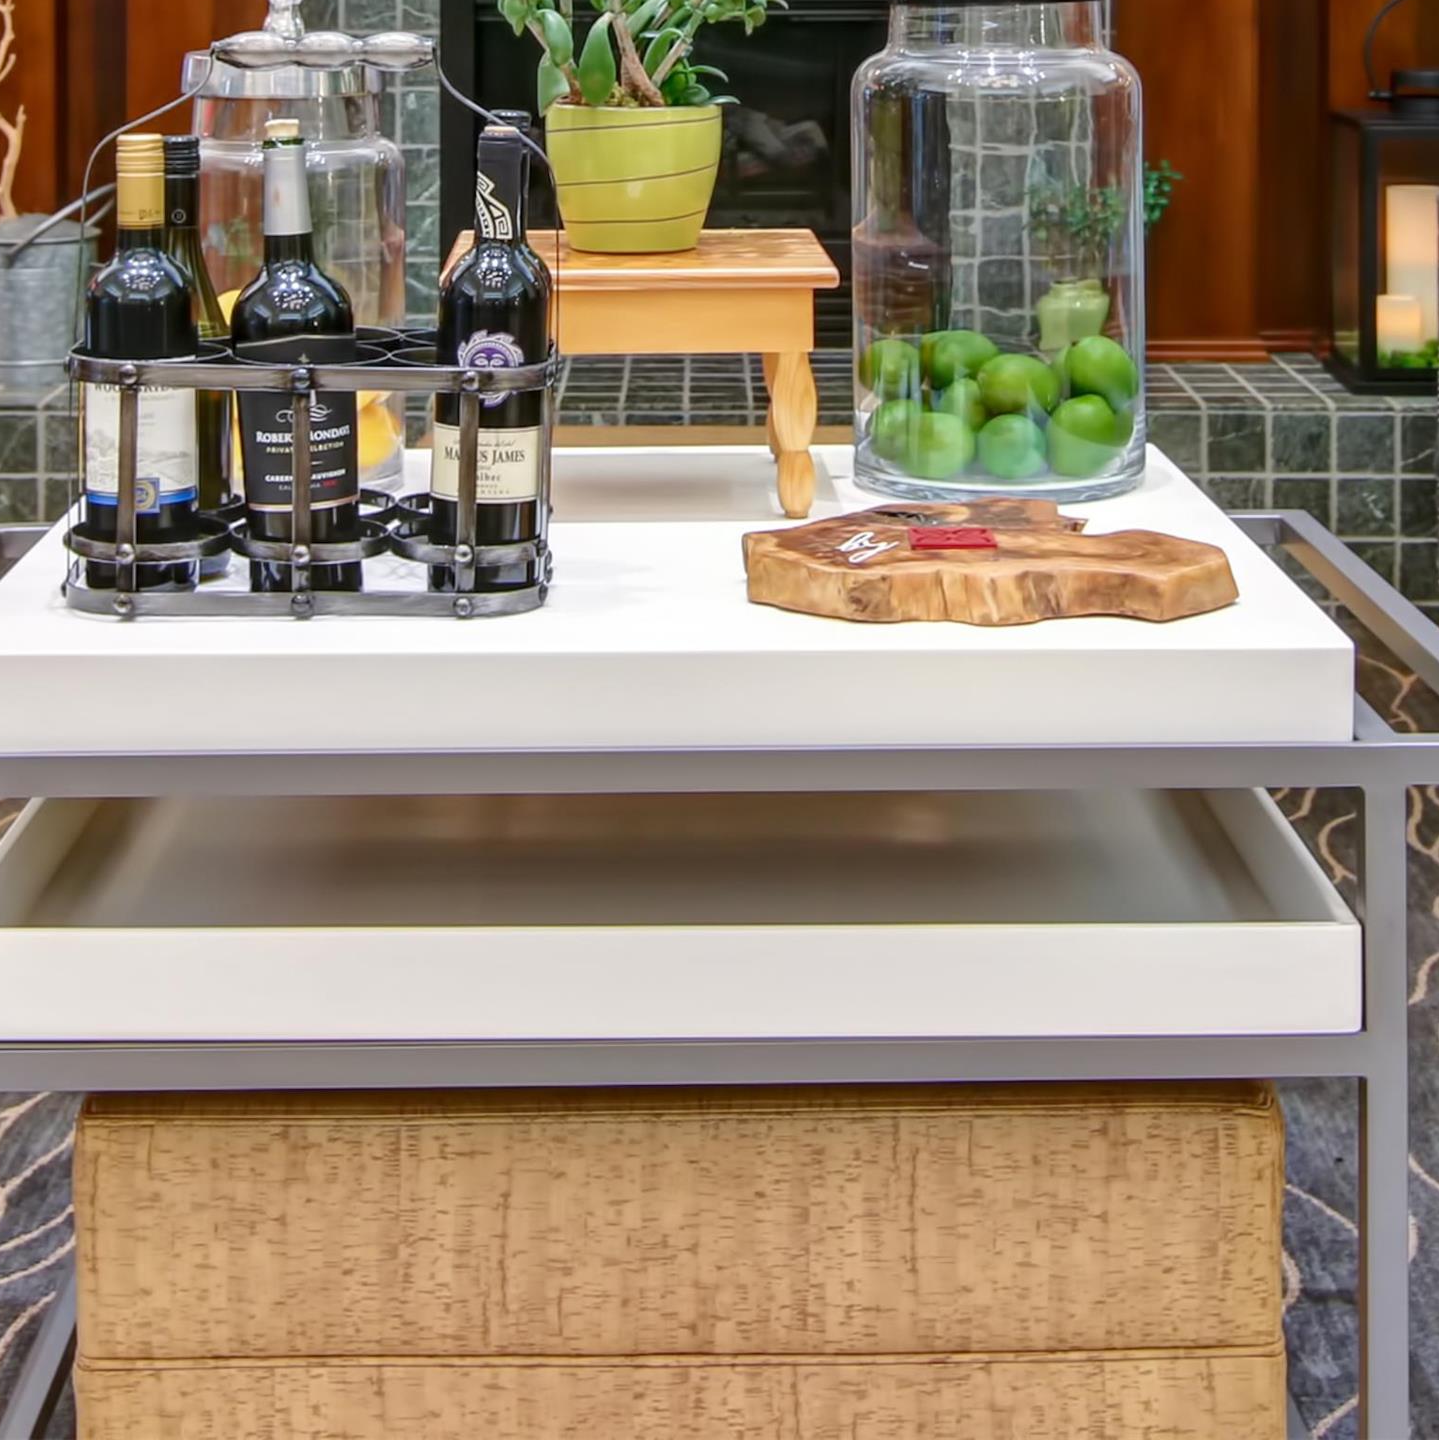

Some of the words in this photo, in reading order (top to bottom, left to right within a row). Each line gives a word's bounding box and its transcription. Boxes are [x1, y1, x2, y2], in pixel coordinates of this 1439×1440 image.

[256, 431, 294, 443] ROBER
[491, 449, 525, 465] JAMES
[835, 532, 900, 564] by
